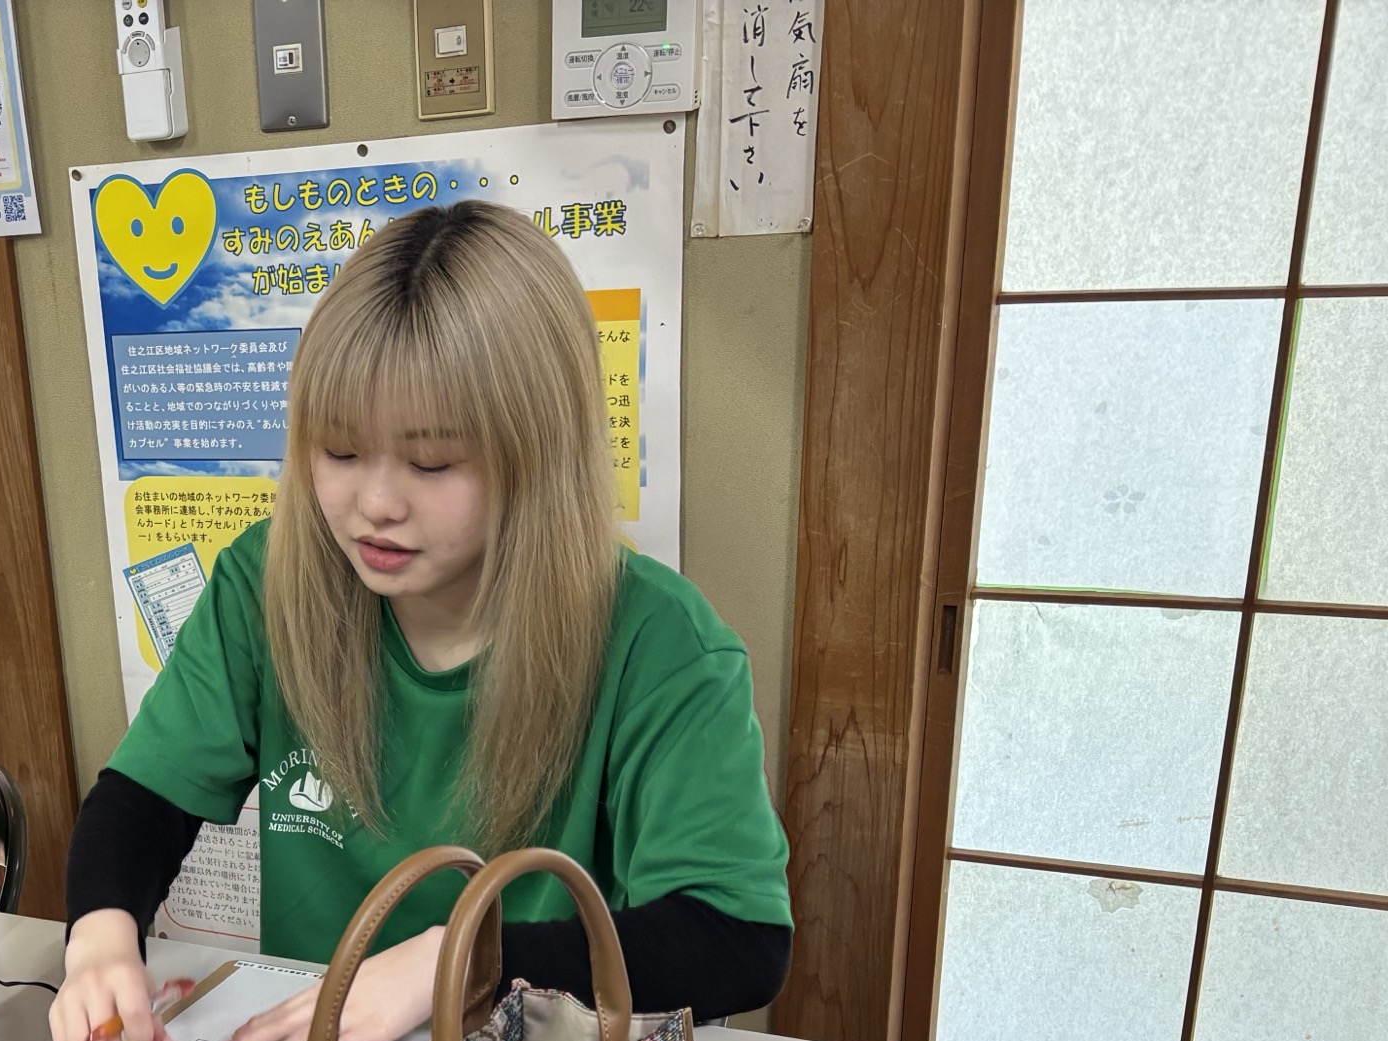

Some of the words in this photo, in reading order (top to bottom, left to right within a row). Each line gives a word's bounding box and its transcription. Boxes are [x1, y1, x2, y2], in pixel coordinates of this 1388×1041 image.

[787, 0, 816, 136] 気扇を
[222, 217, 395, 257] すみのえあん
[127, 341, 288, 357] 住之江区地域ネットワーク委員会及び
[268, 822, 305, 833] MEDICAL
[307, 826, 344, 850] SCIENCES
[271, 813, 330, 833] UNIVERSITY
[331, 830, 344, 841] OF
